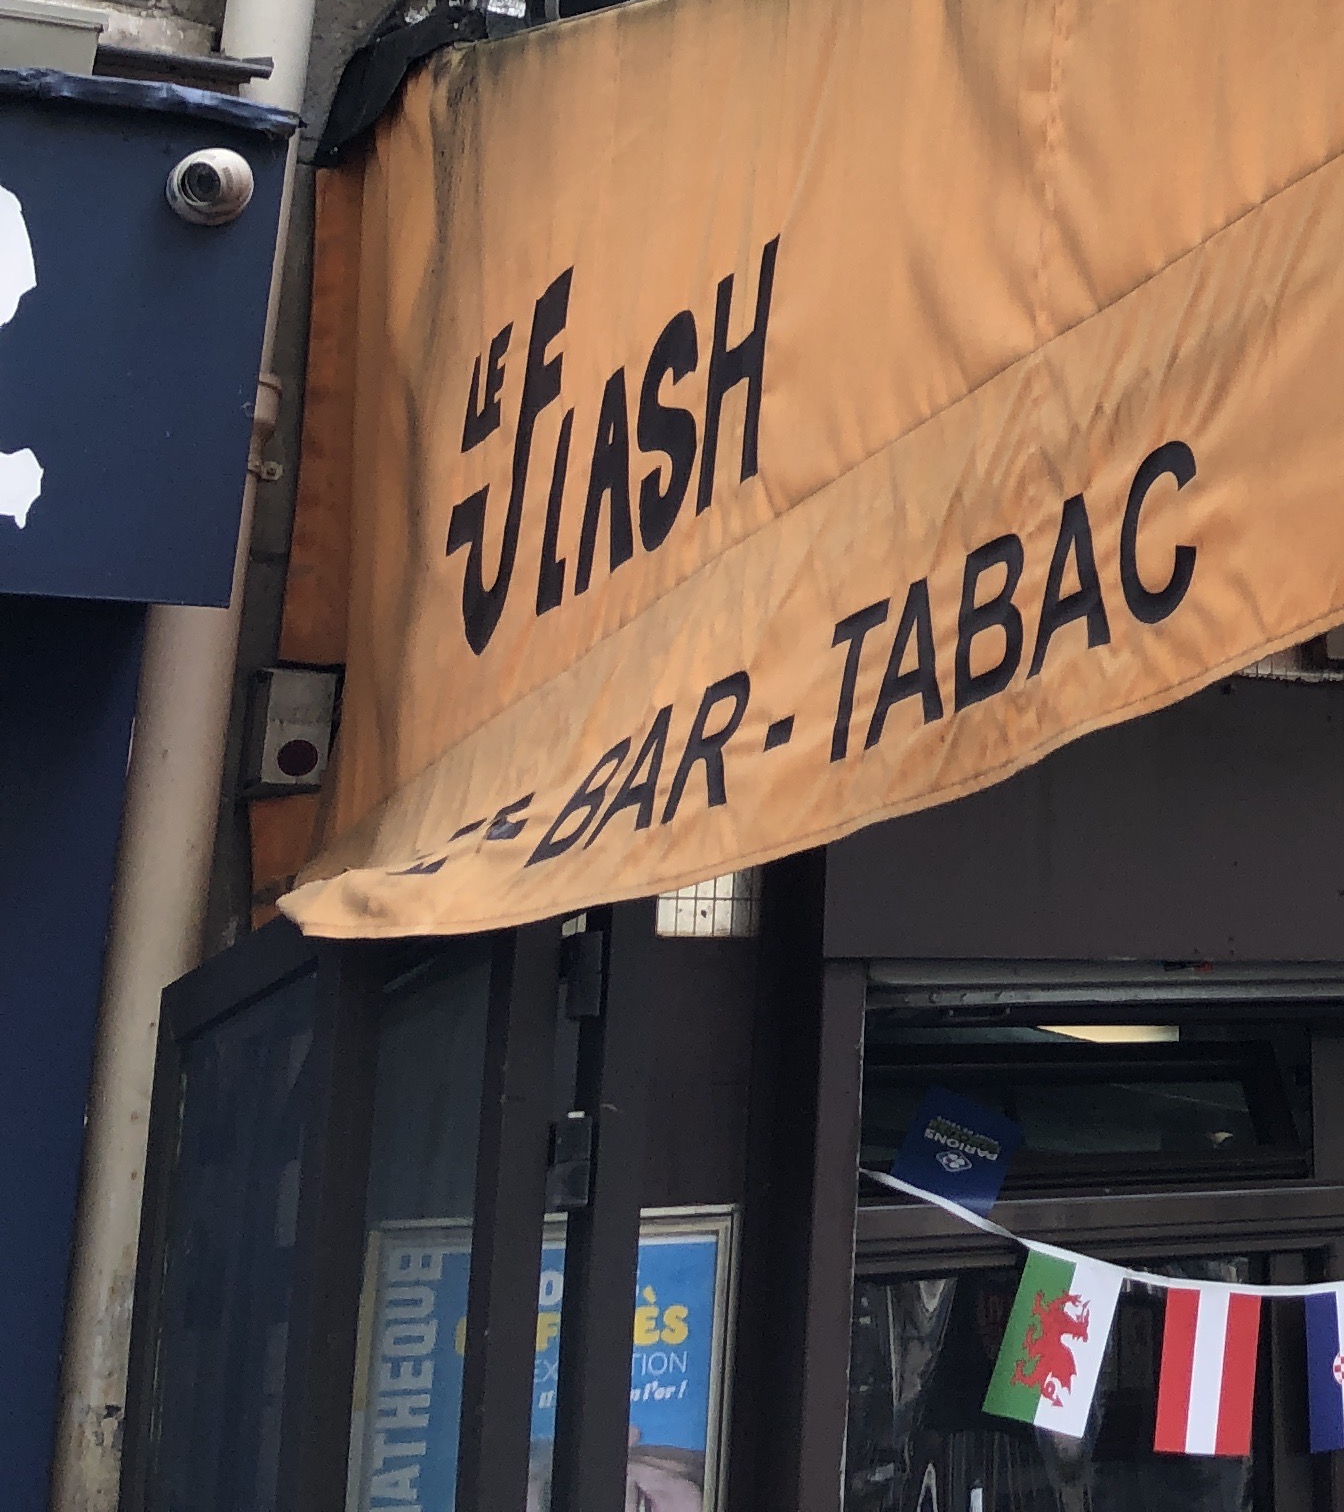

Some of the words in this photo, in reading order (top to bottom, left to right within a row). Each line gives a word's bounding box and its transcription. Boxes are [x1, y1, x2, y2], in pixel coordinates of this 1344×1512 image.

[445, 233, 780, 656] FLASH
[460, 322, 514, 454] LE
[526, 670, 751, 869] BAR
[830, 439, 1198, 763] TABAC
